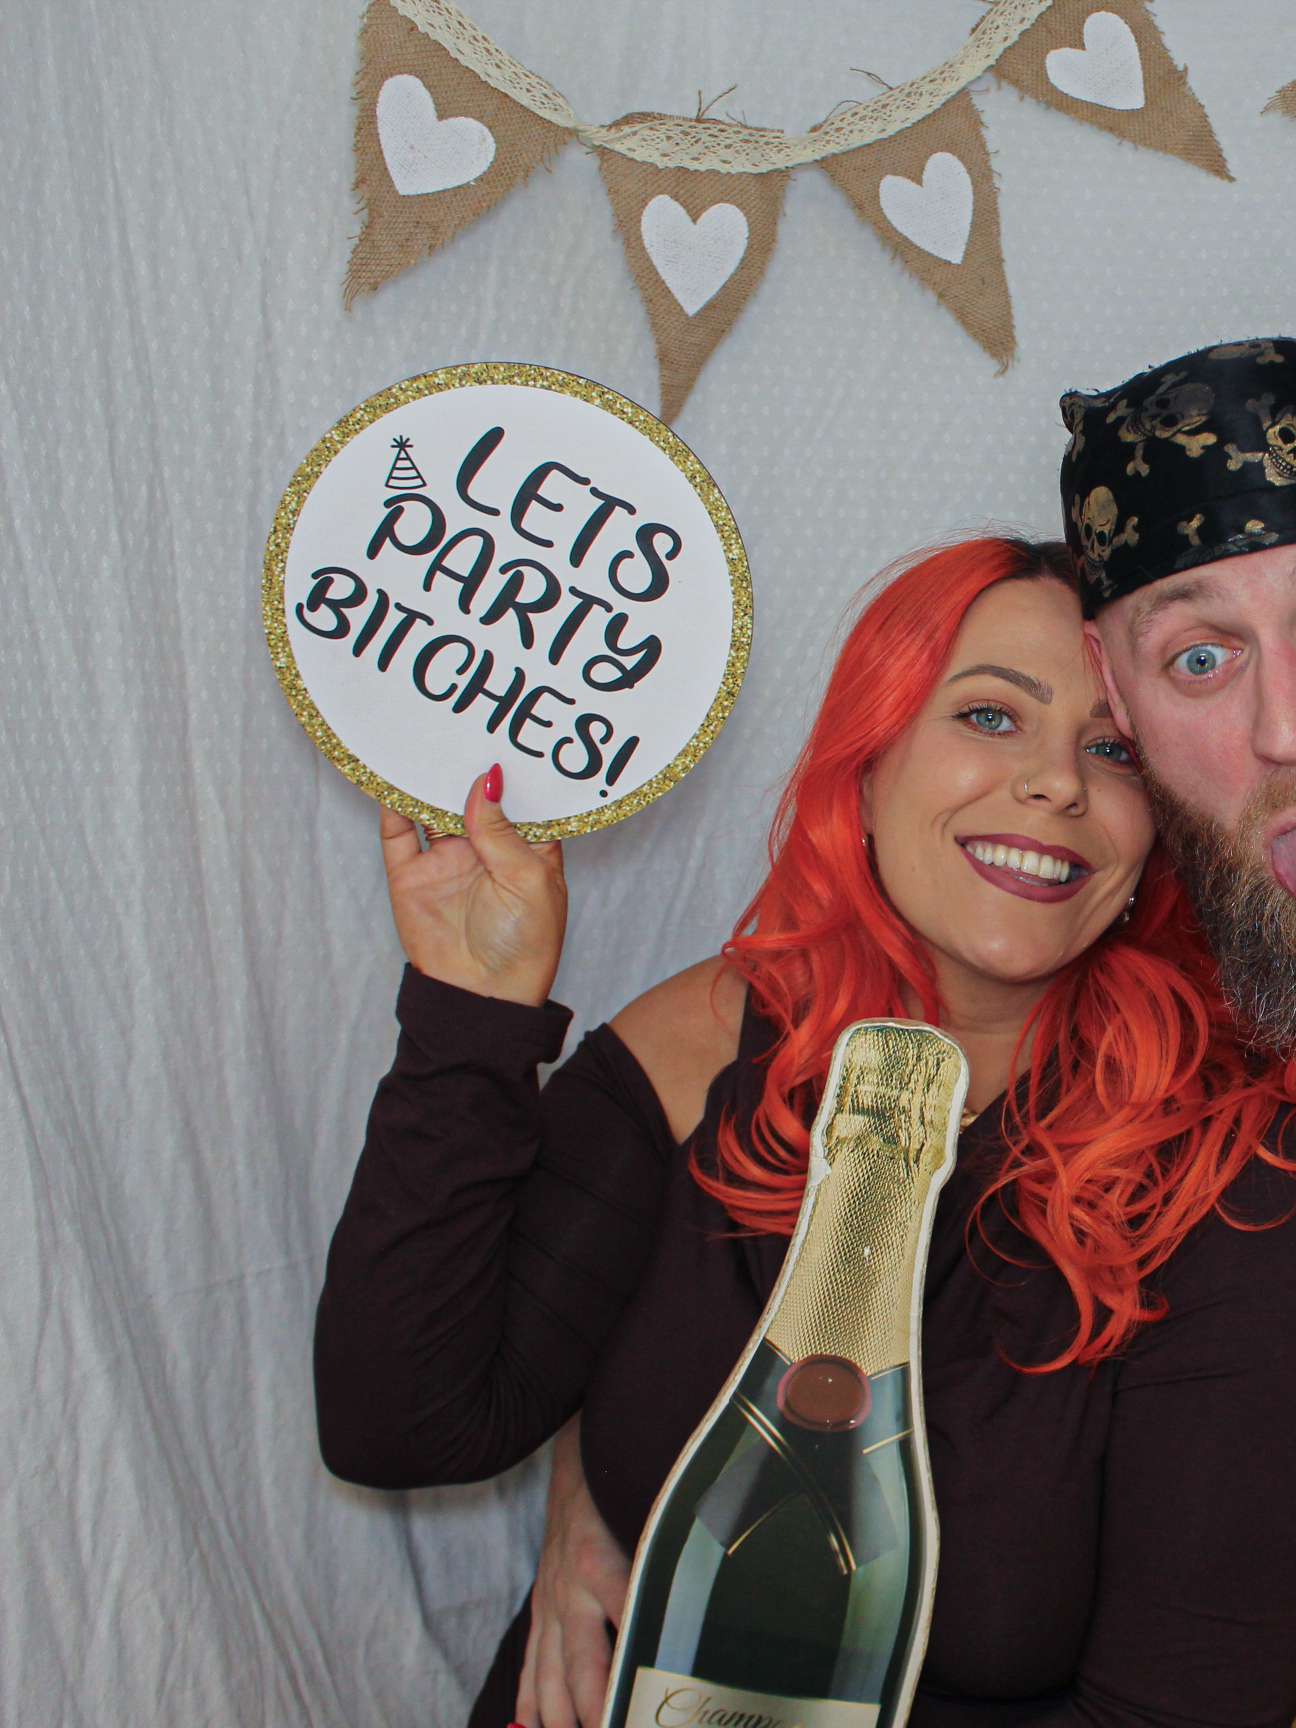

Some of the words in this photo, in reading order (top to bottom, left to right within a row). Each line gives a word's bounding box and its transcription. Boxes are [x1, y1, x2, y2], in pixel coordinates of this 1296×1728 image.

[366, 493, 662, 692] PARTY
[456, 426, 682, 602] LETS
[295, 566, 640, 798] BITCHES!
